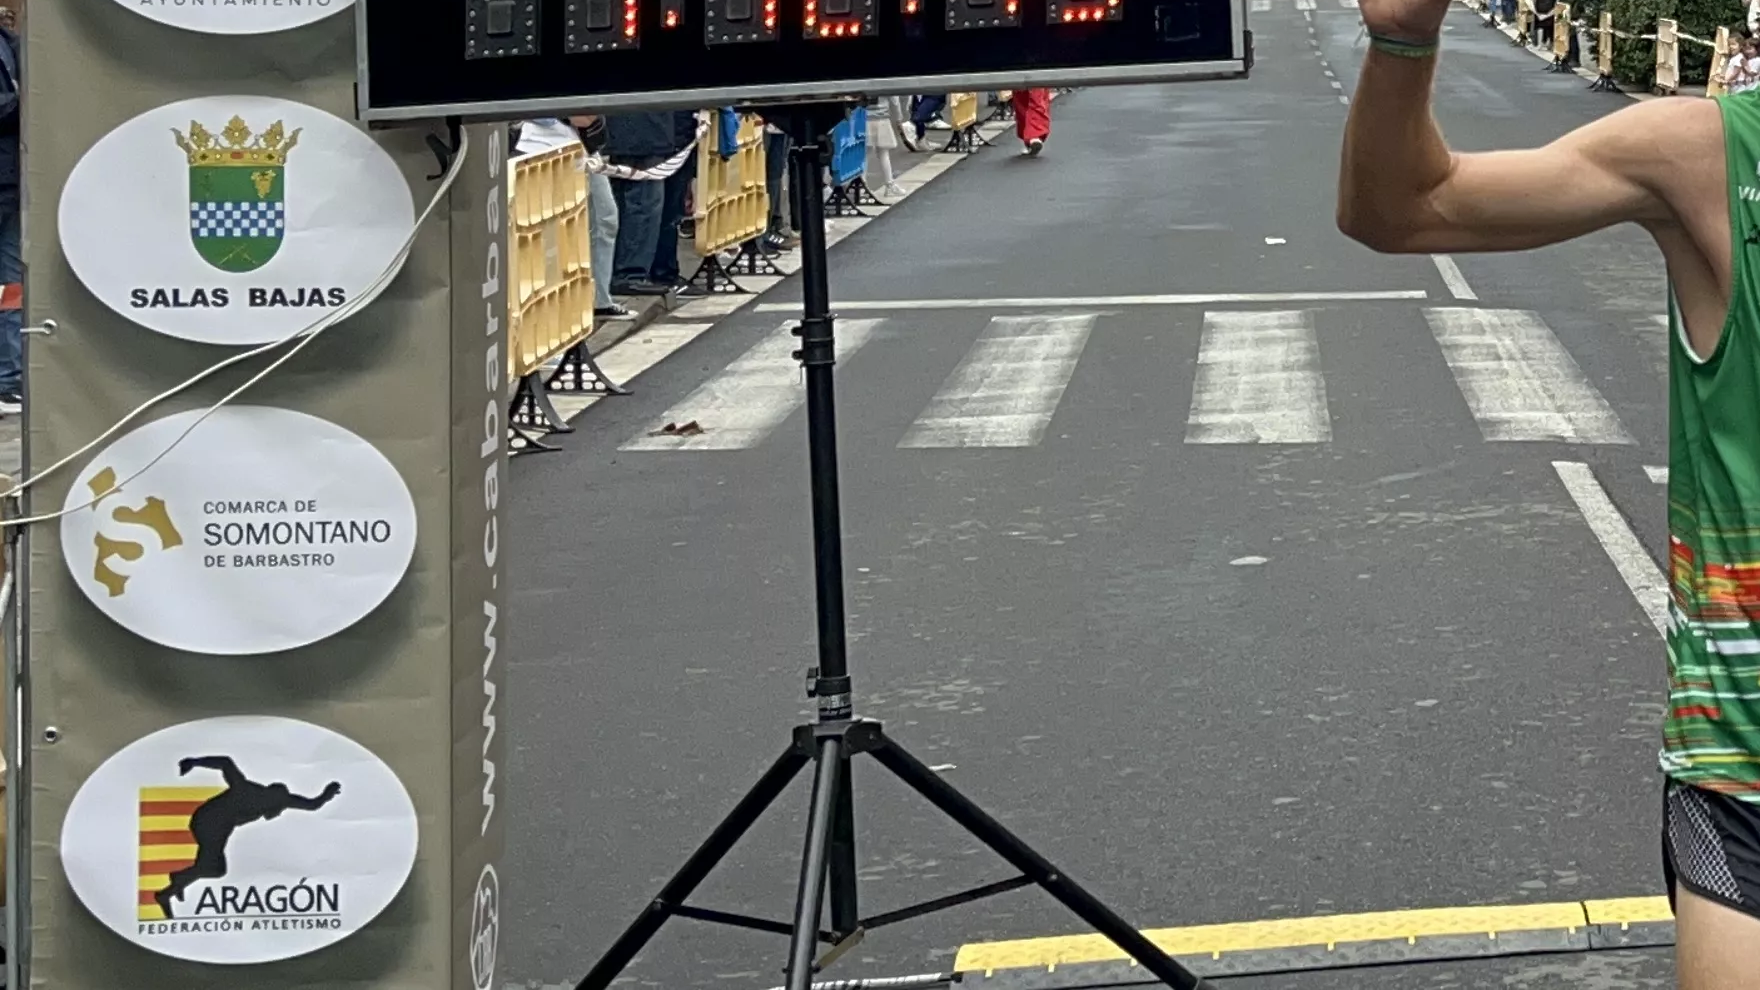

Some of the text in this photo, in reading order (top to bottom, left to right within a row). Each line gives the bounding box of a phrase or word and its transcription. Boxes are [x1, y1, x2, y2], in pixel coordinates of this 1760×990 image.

[130, 286, 346, 309] SALAS BAJAS
[203, 499, 317, 515] COMARCA DE
[203, 519, 392, 547] SOMONTANO
[203, 553, 335, 568] DE BARBASTRO
[194, 877, 339, 914] ARAGÓN
[138, 917, 342, 935] FEDERACIÓN ATLETISMO
